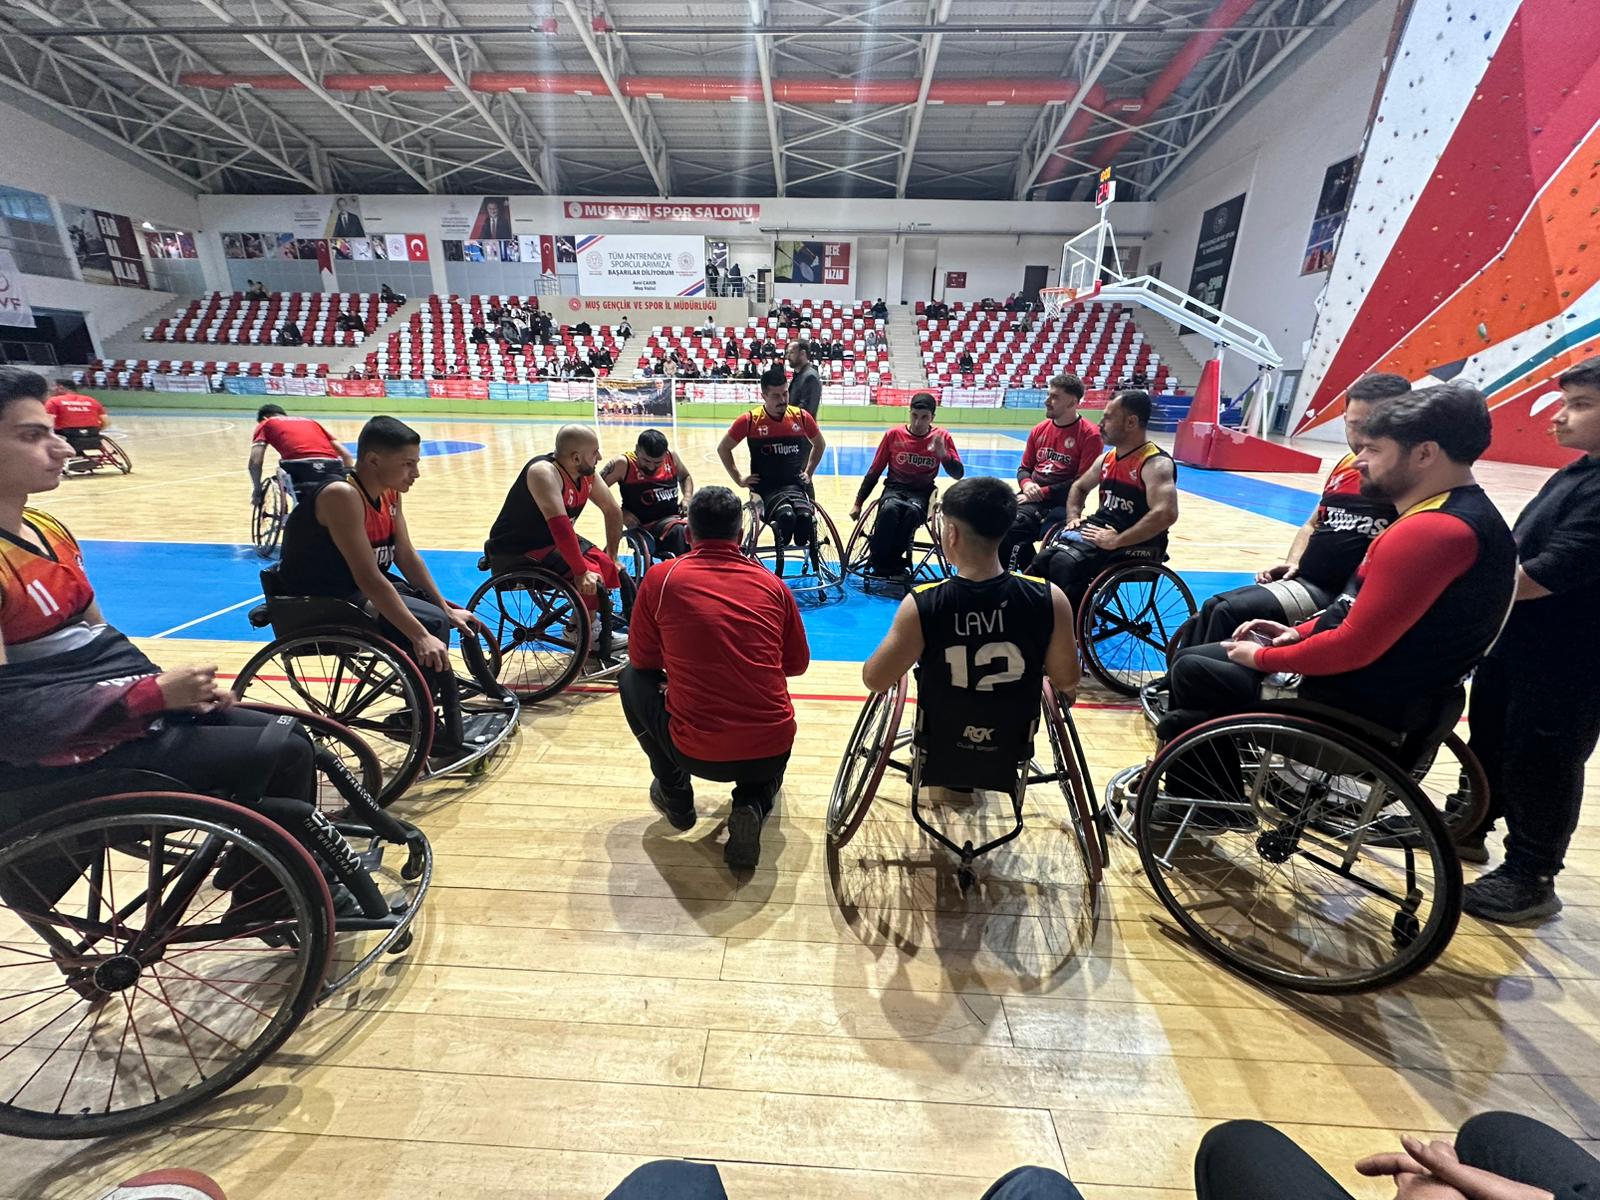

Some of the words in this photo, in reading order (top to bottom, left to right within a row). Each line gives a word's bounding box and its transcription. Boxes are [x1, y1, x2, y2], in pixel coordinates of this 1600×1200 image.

[1097, 182, 1110, 204] 24
[618, 203, 651, 217] YENİ
[654, 206, 692, 218] SPOR
[695, 207, 752, 218] SALONU
[608, 252, 624, 260] TÜM
[626, 252, 663, 260] ANTRENÖR
[664, 252, 672, 260] VE
[611, 260, 671, 268] SPORCULARIMIZA
[585, 301, 601, 311] MUŞ
[602, 300, 631, 311] GENÇLİK
[634, 301, 643, 310] VE
[644, 301, 663, 310] SPOR
[665, 300, 672, 310] İL
[674, 300, 717, 310] MÜDÜRLÜĞÜ
[26, 579, 60, 617] 11
[945, 641, 1026, 692] 12
[332, 759, 346, 773] THE
[303, 817, 319, 832] THE
[311, 807, 362, 872] EXTRA
